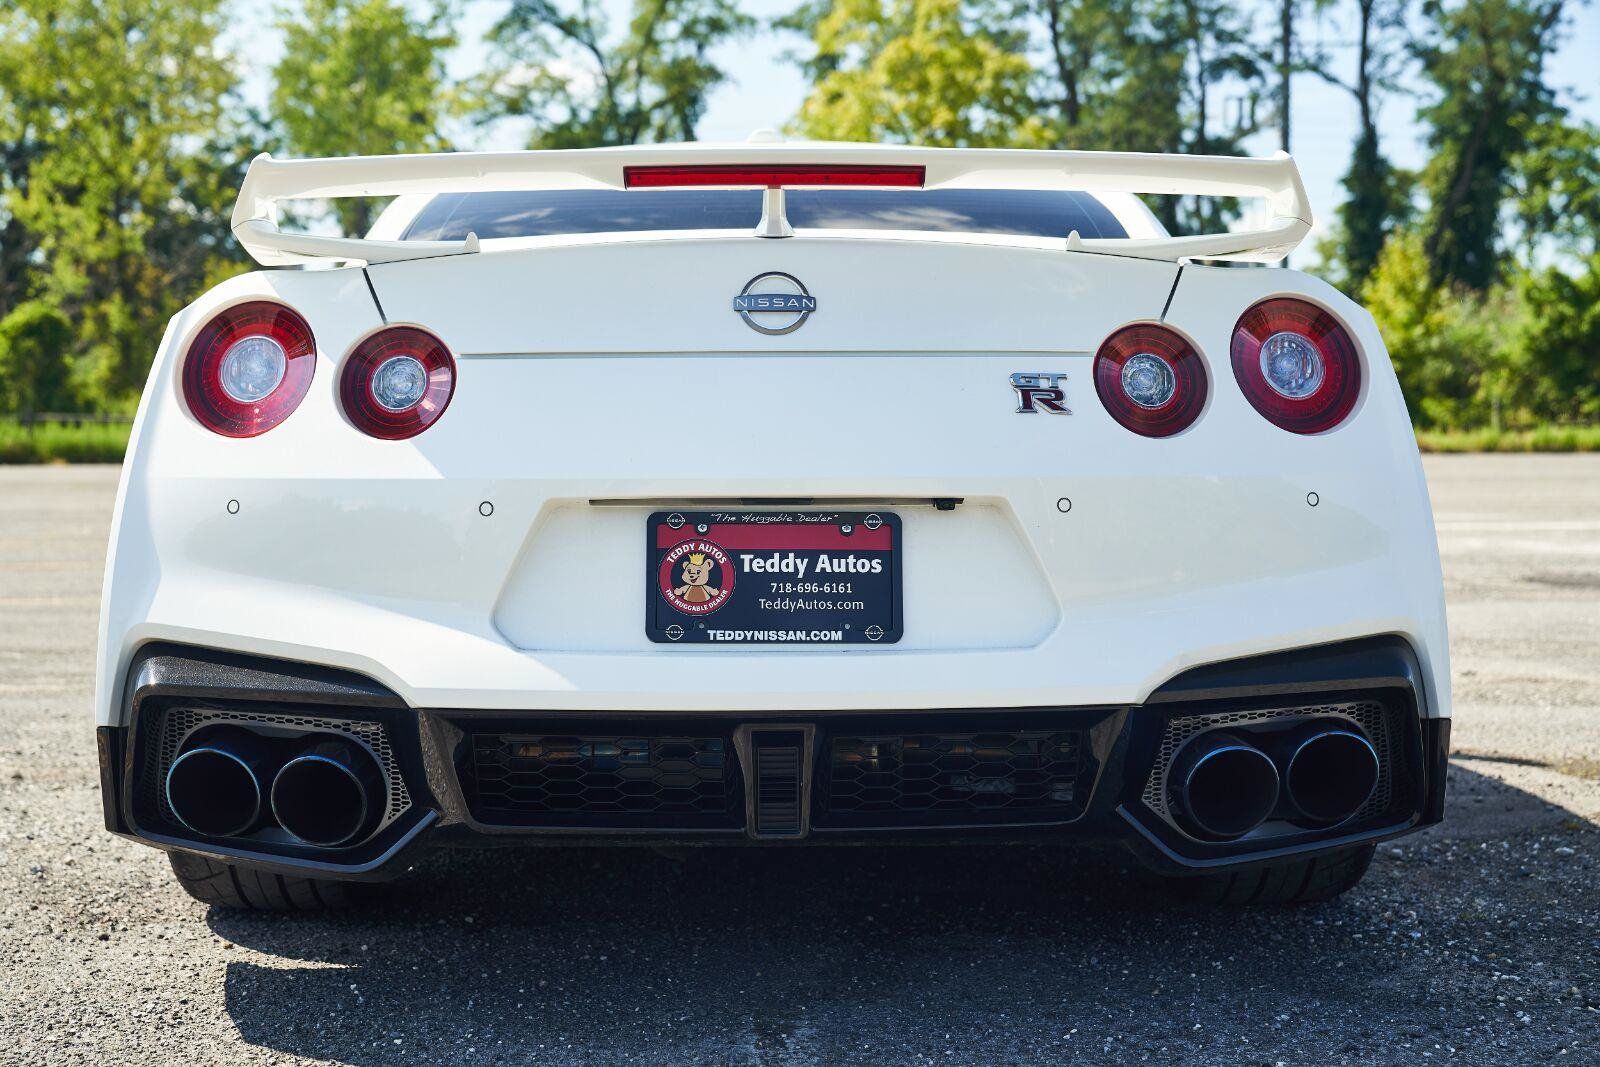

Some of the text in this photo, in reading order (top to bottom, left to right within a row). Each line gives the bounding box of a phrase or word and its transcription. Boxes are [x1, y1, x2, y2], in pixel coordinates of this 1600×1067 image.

[736, 298, 814, 308] NISSAN
[741, 513, 793, 524] Huggable
[667, 543, 727, 564] TEDDY AUTOS
[740, 552, 883, 578] Teddy Autos
[770, 582, 852, 593] 718-696-6161
[665, 588, 728, 612] THE HUGGABLE DEALER
[759, 598, 864, 612] TeddyAutos.com
[707, 630, 843, 641] TEDDYNISSAN.COM
